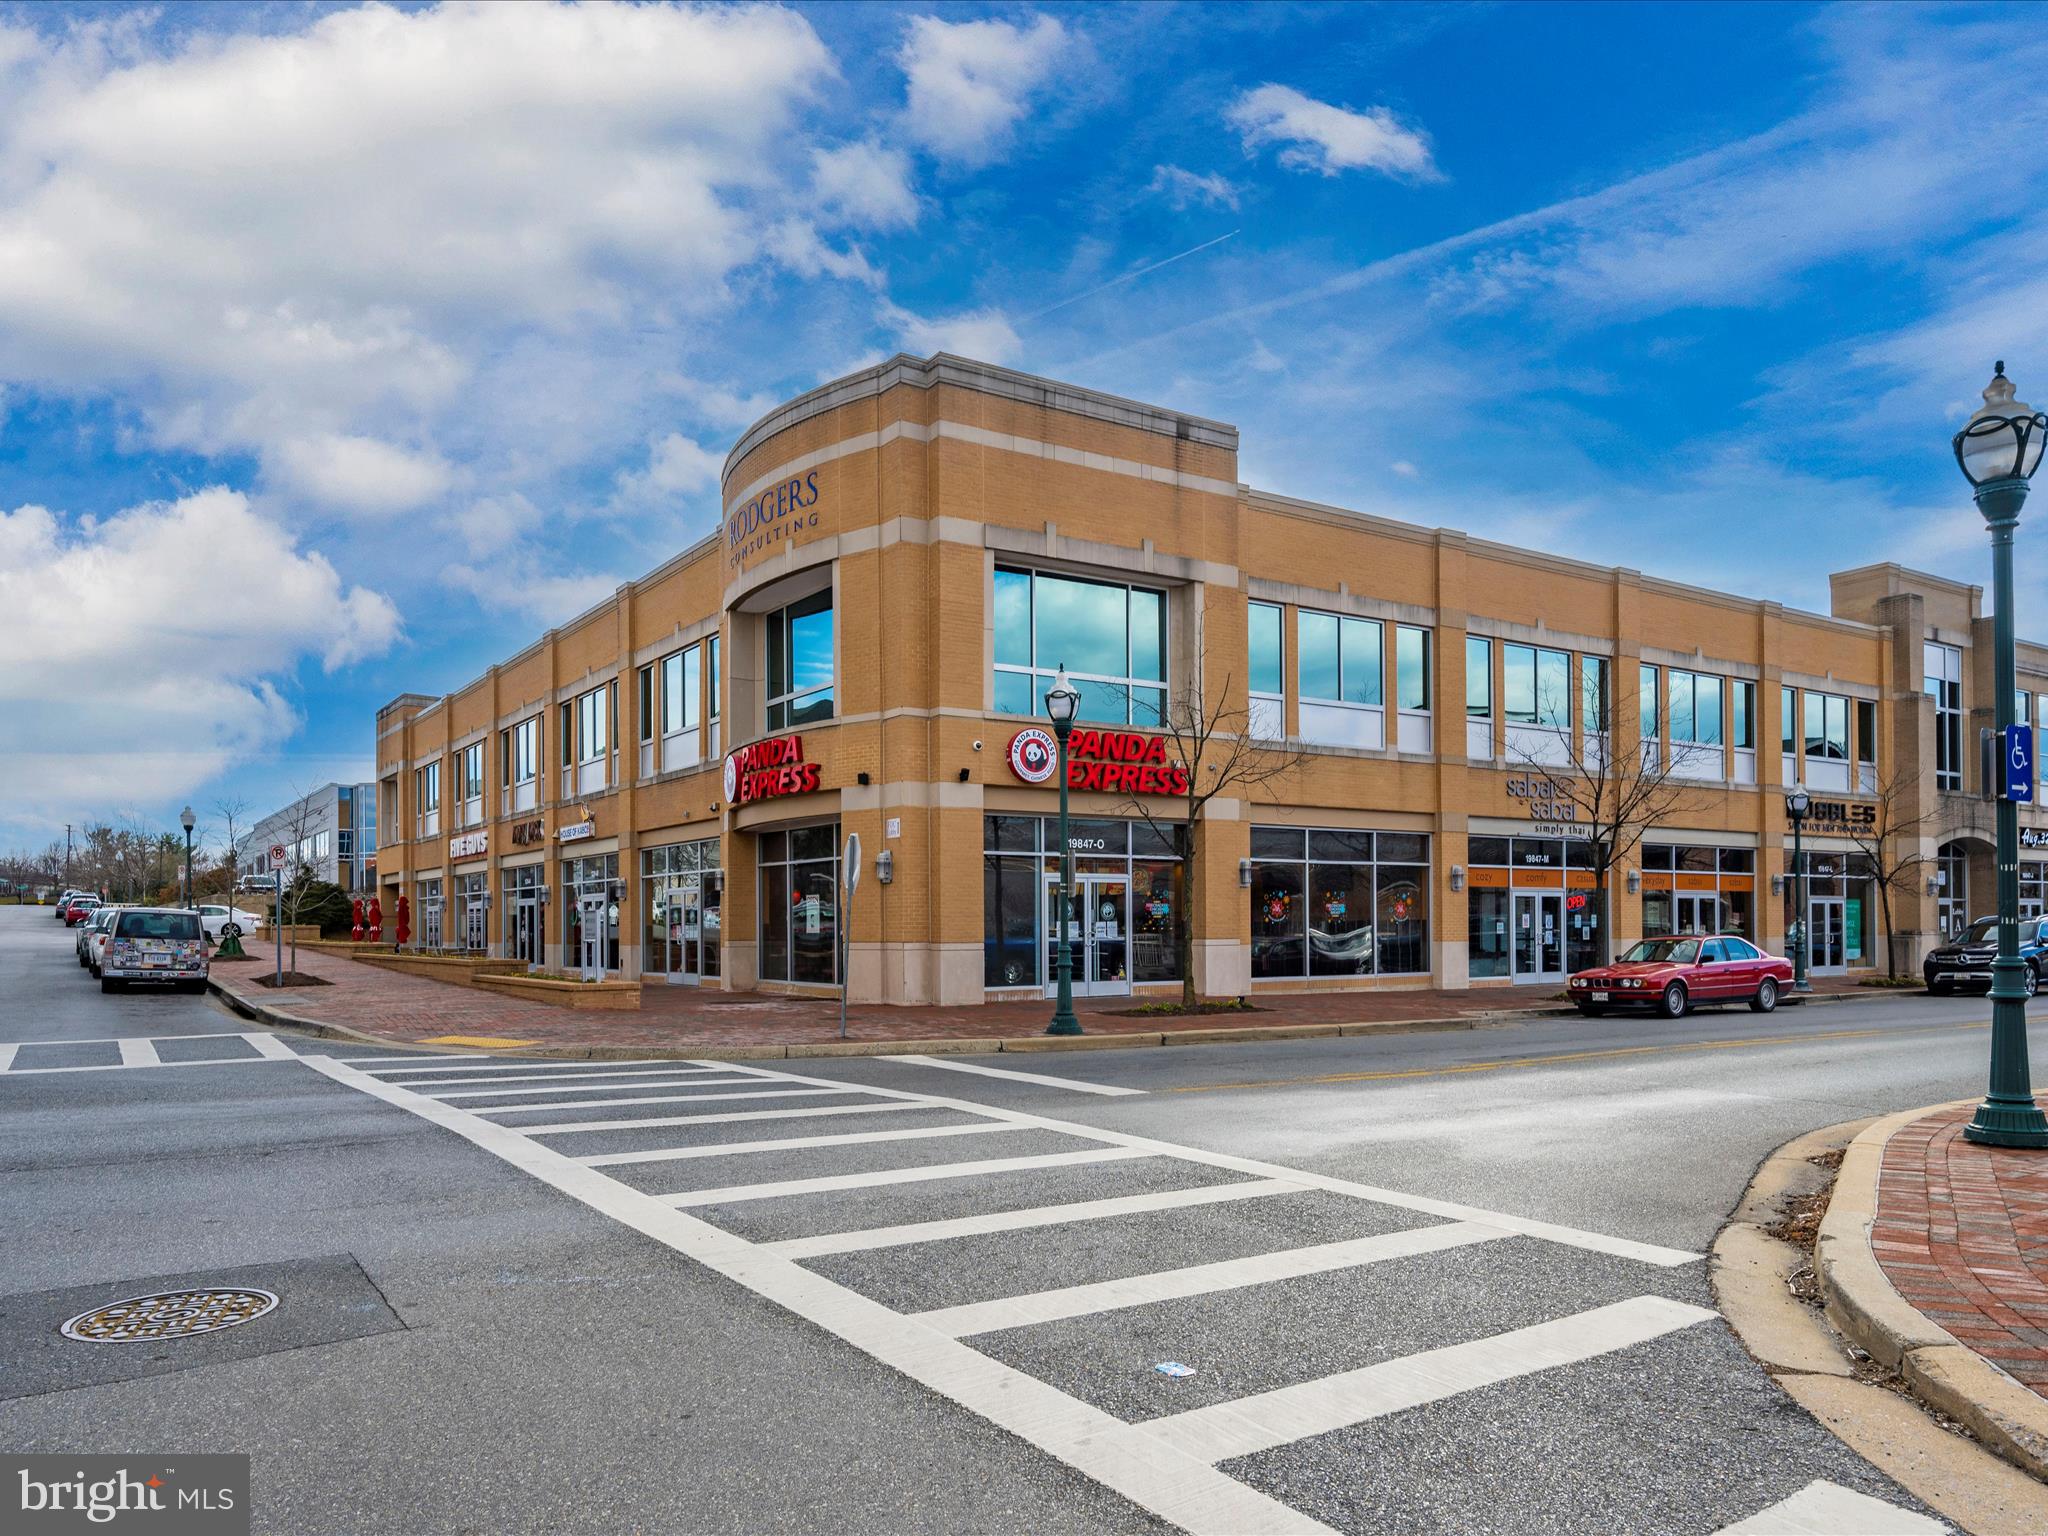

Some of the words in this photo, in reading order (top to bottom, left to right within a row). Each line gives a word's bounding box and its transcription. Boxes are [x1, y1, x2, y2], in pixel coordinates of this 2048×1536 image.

[730, 471, 818, 550] RODGERS
[730, 512, 818, 570] CONSULTING
[741, 736, 804, 773] PANDA
[1014, 732, 1031, 754] PANDA
[1032, 731, 1056, 757] EXPRESS
[1067, 729, 1167, 765] PANDA
[741, 763, 821, 800] EXPRESS
[1067, 760, 1188, 795] EXPRESS
[560, 828, 573, 839] HOUSE
[1535, 822, 1565, 835] simply
[1568, 825, 1586, 835] thai
[466, 831, 488, 856] GUYS
[1068, 838, 1105, 850] 19847-O
[1525, 854, 1550, 863] 19847-M
[1475, 874, 1493, 882] cozy
[1526, 873, 1547, 885] comfy
[1567, 896, 1586, 910] OPEN
